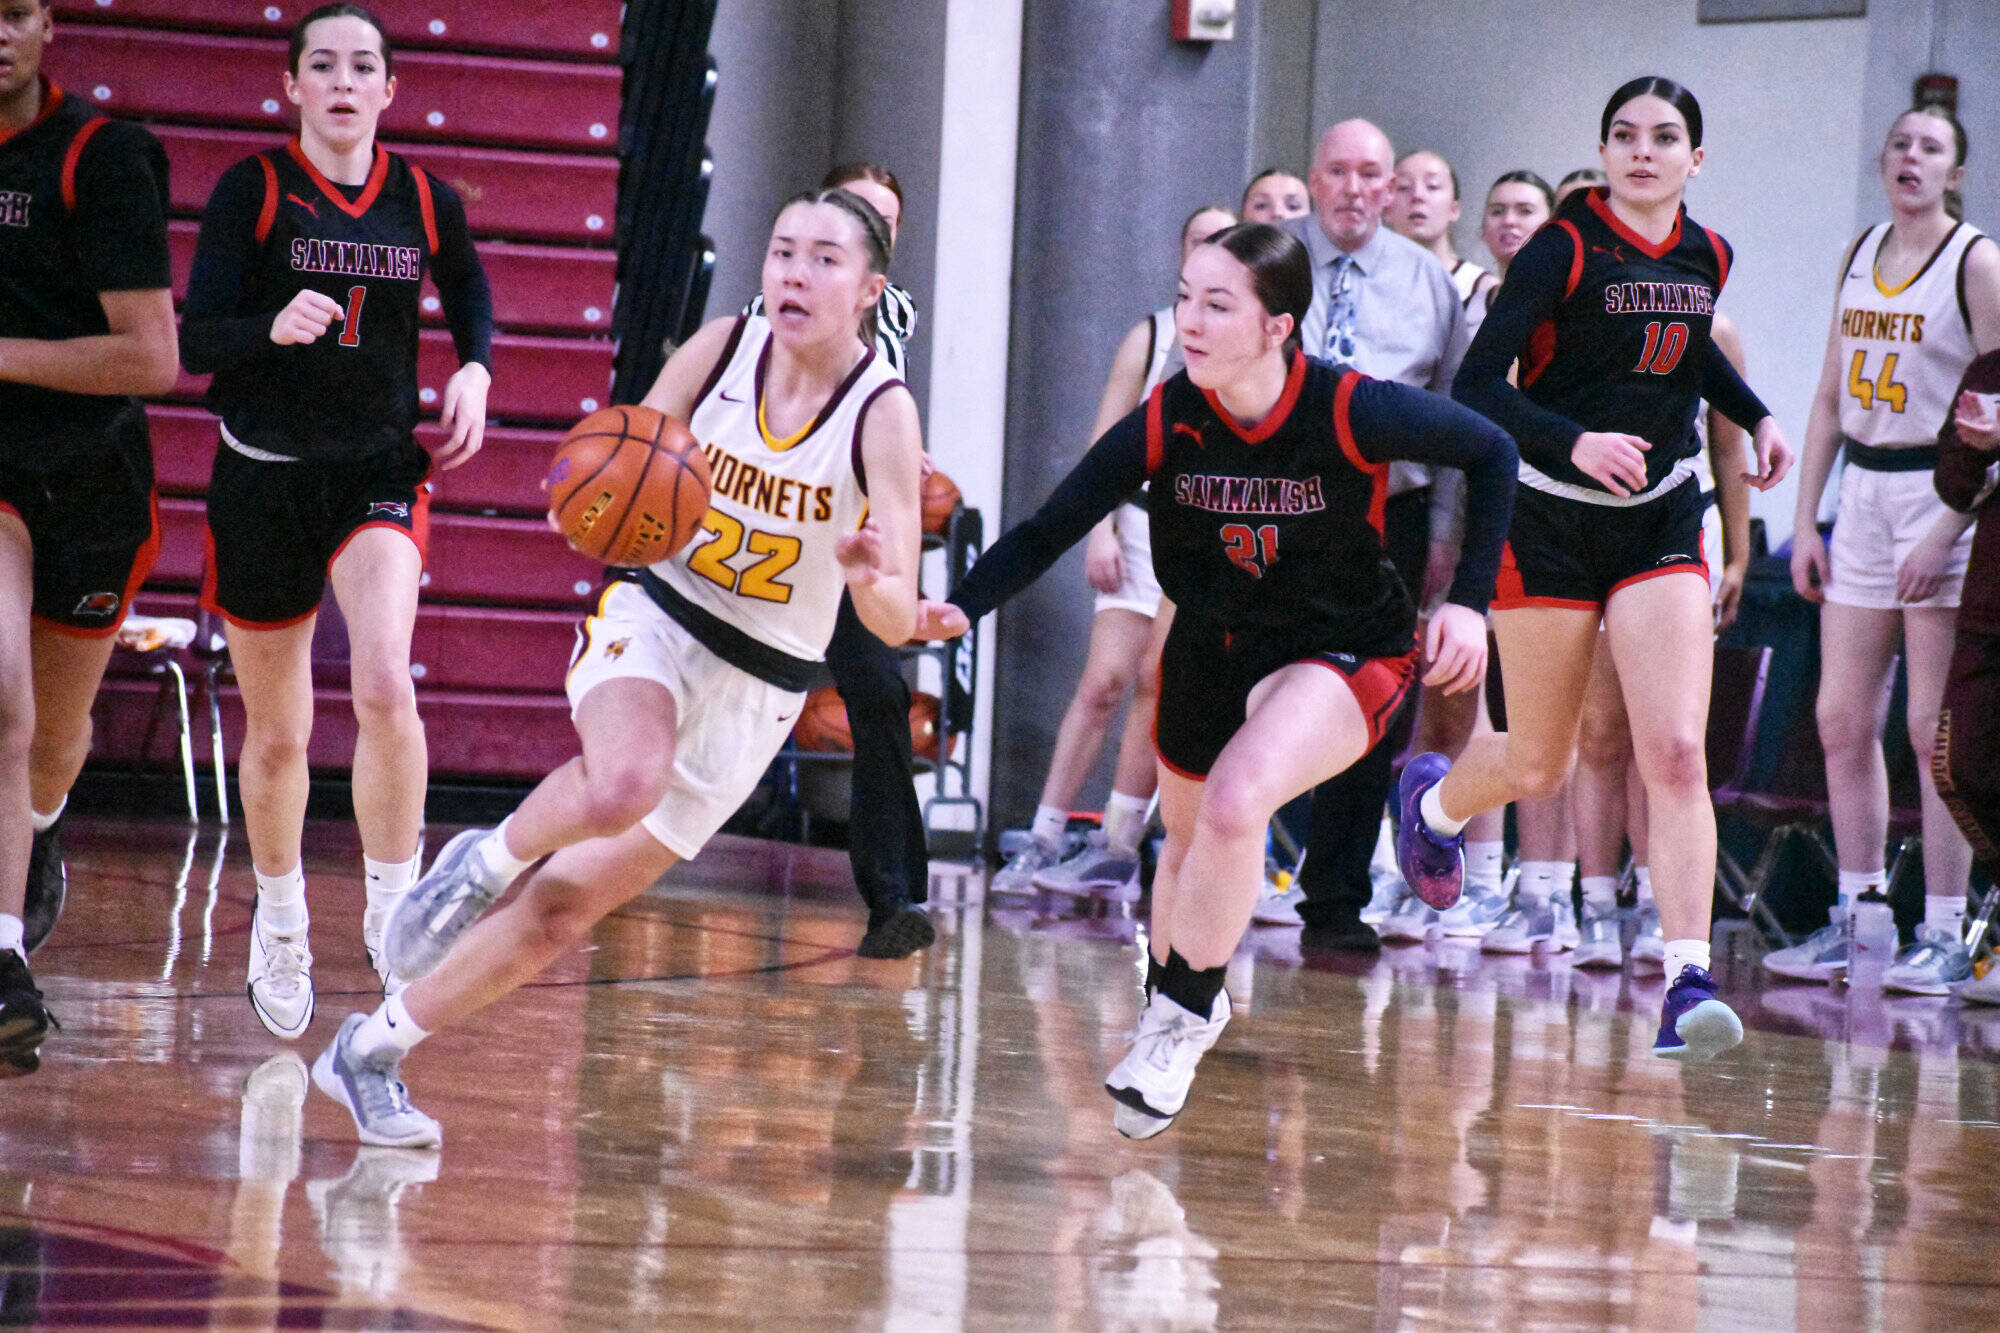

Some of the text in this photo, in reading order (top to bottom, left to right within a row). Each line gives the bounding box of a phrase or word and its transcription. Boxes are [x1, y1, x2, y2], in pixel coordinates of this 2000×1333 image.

[291, 238, 420, 280] SAMMAMISH
[338, 285, 367, 347] 1
[1841, 308, 1926, 343] HORNETS
[1632, 321, 1690, 375] 10
[1848, 349, 1908, 414] 44
[1175, 474, 1326, 515] SAMMAMISH
[687, 504, 803, 604] 22
[1220, 523, 1279, 579] 21
